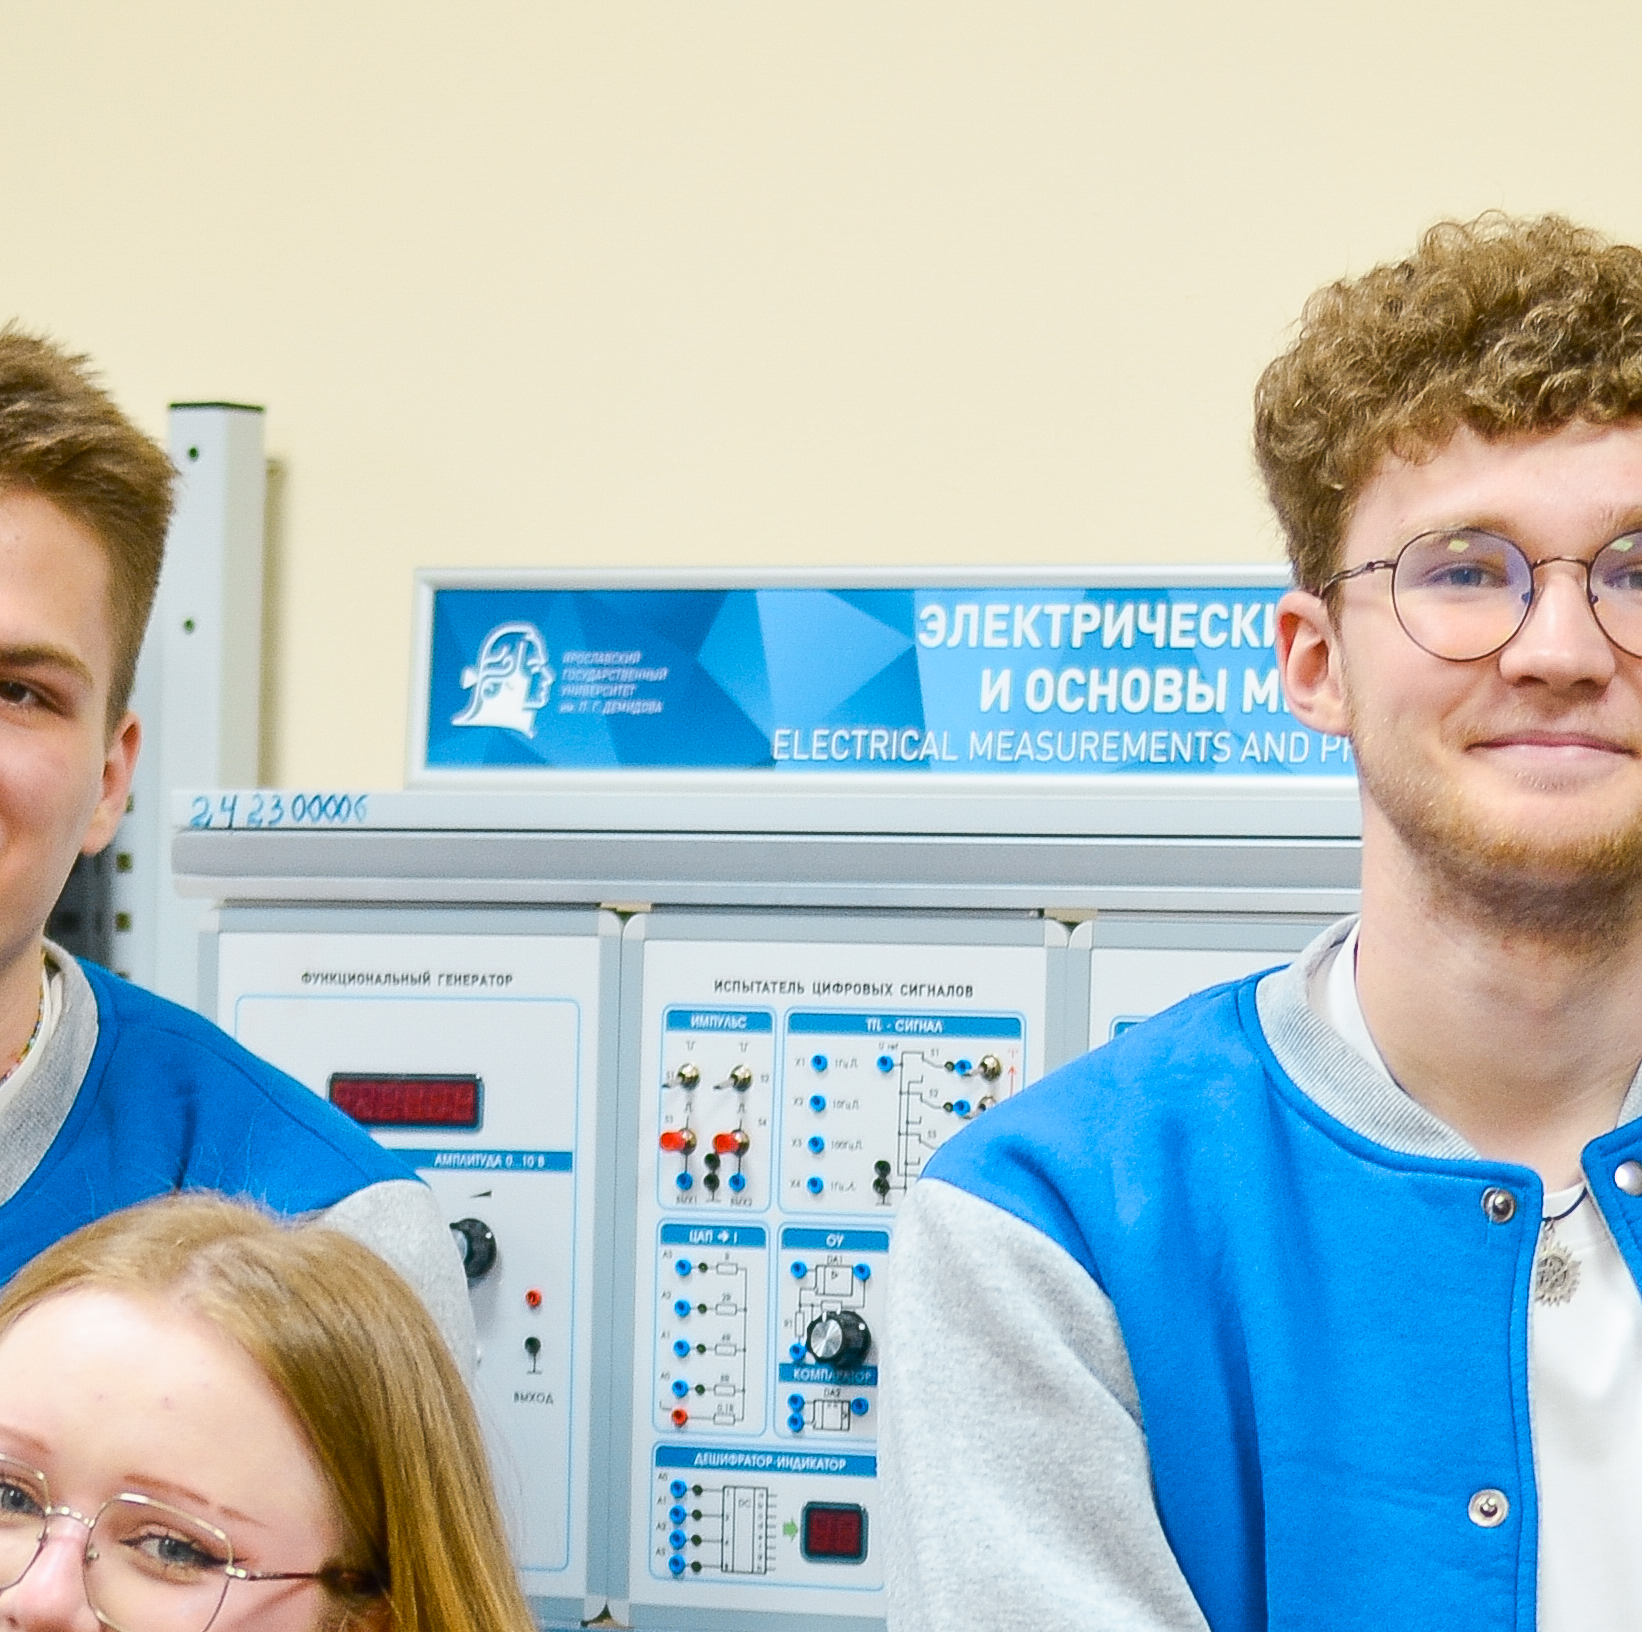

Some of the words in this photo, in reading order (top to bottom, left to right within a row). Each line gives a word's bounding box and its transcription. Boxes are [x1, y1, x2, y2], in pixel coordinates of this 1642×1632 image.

[561, 650, 643, 664] ЯРОСЛАВСКИЙ
[561, 666, 669, 681] ГОСУДАРСТВЕННЫЙ
[560, 683, 637, 697] УНИВЕРСИТЕТ
[980, 668, 1012, 713] И
[1025, 667, 1228, 714] ОСНОВЫ
[1241, 667, 1290, 714] М
[602, 700, 664, 715] ДЕМИДОВА
[772, 729, 957, 763] ELECTRICAL
[968, 730, 1232, 764] MEASUREMENTS
[1240, 732, 1309, 764] AND
[301, 970, 431, 988] ФУНКЦИОНАЛЬНЫЙ
[438, 974, 514, 988] ГЕНЕРАТОР
[714, 979, 805, 995] ИСПЫТАТЕЛЬ
[812, 982, 893, 998] ЦИФРОВЫХ
[900, 984, 974, 998] СИГНАЛОВ
[690, 1012, 748, 1030] ИМПУЛЬС
[895, 1018, 944, 1034] СИГНАЛ
[435, 1153, 503, 1168] АМПЛИТУДА
[689, 1230, 714, 1244] ЦАП
[826, 1234, 844, 1247] ОУ
[513, 1391, 554, 1405] ВЫХОД
[694, 1452, 847, 1471] ДЕШИФРАТОР-ИНДИКАТОР
